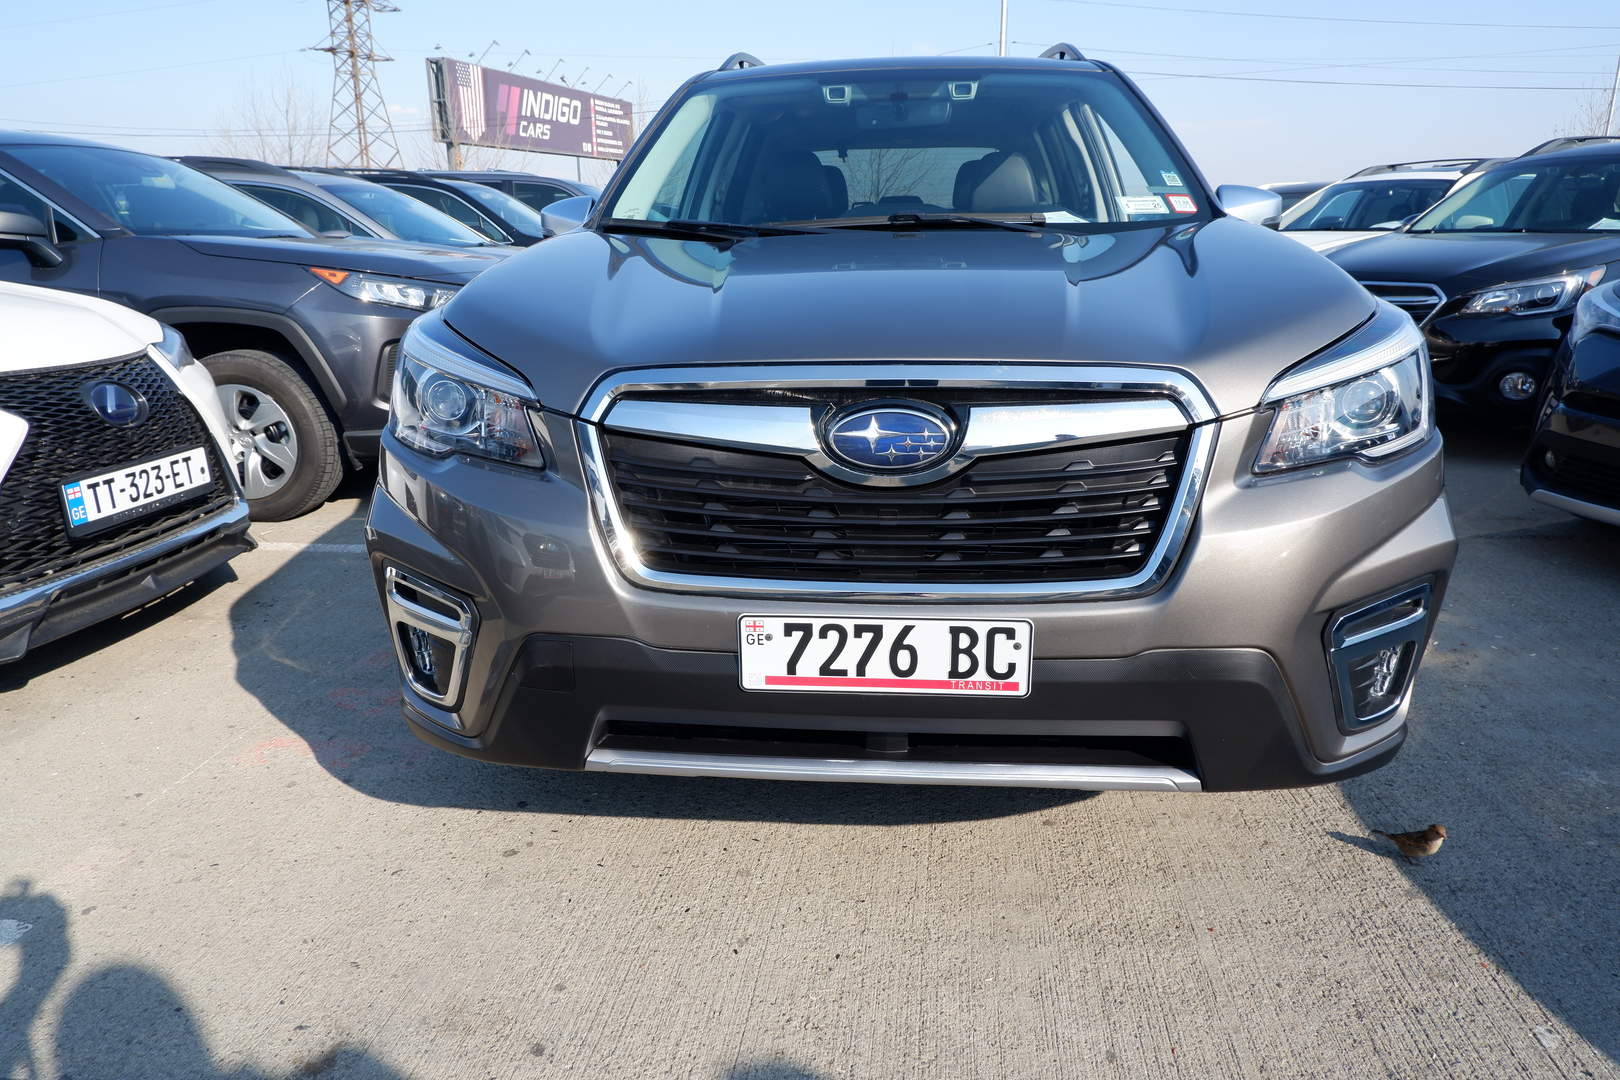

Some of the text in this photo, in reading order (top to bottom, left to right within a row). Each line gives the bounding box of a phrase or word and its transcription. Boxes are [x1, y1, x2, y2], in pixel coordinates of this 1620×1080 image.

[522, 89, 581, 125] INDIGO
[519, 120, 551, 140] CARS
[86, 456, 193, 514] TT-323-ET
[71, 505, 87, 520] GE
[746, 633, 765, 646] GE
[783, 622, 1016, 680] 7276 BC
[950, 680, 1005, 691] TRANSIT
